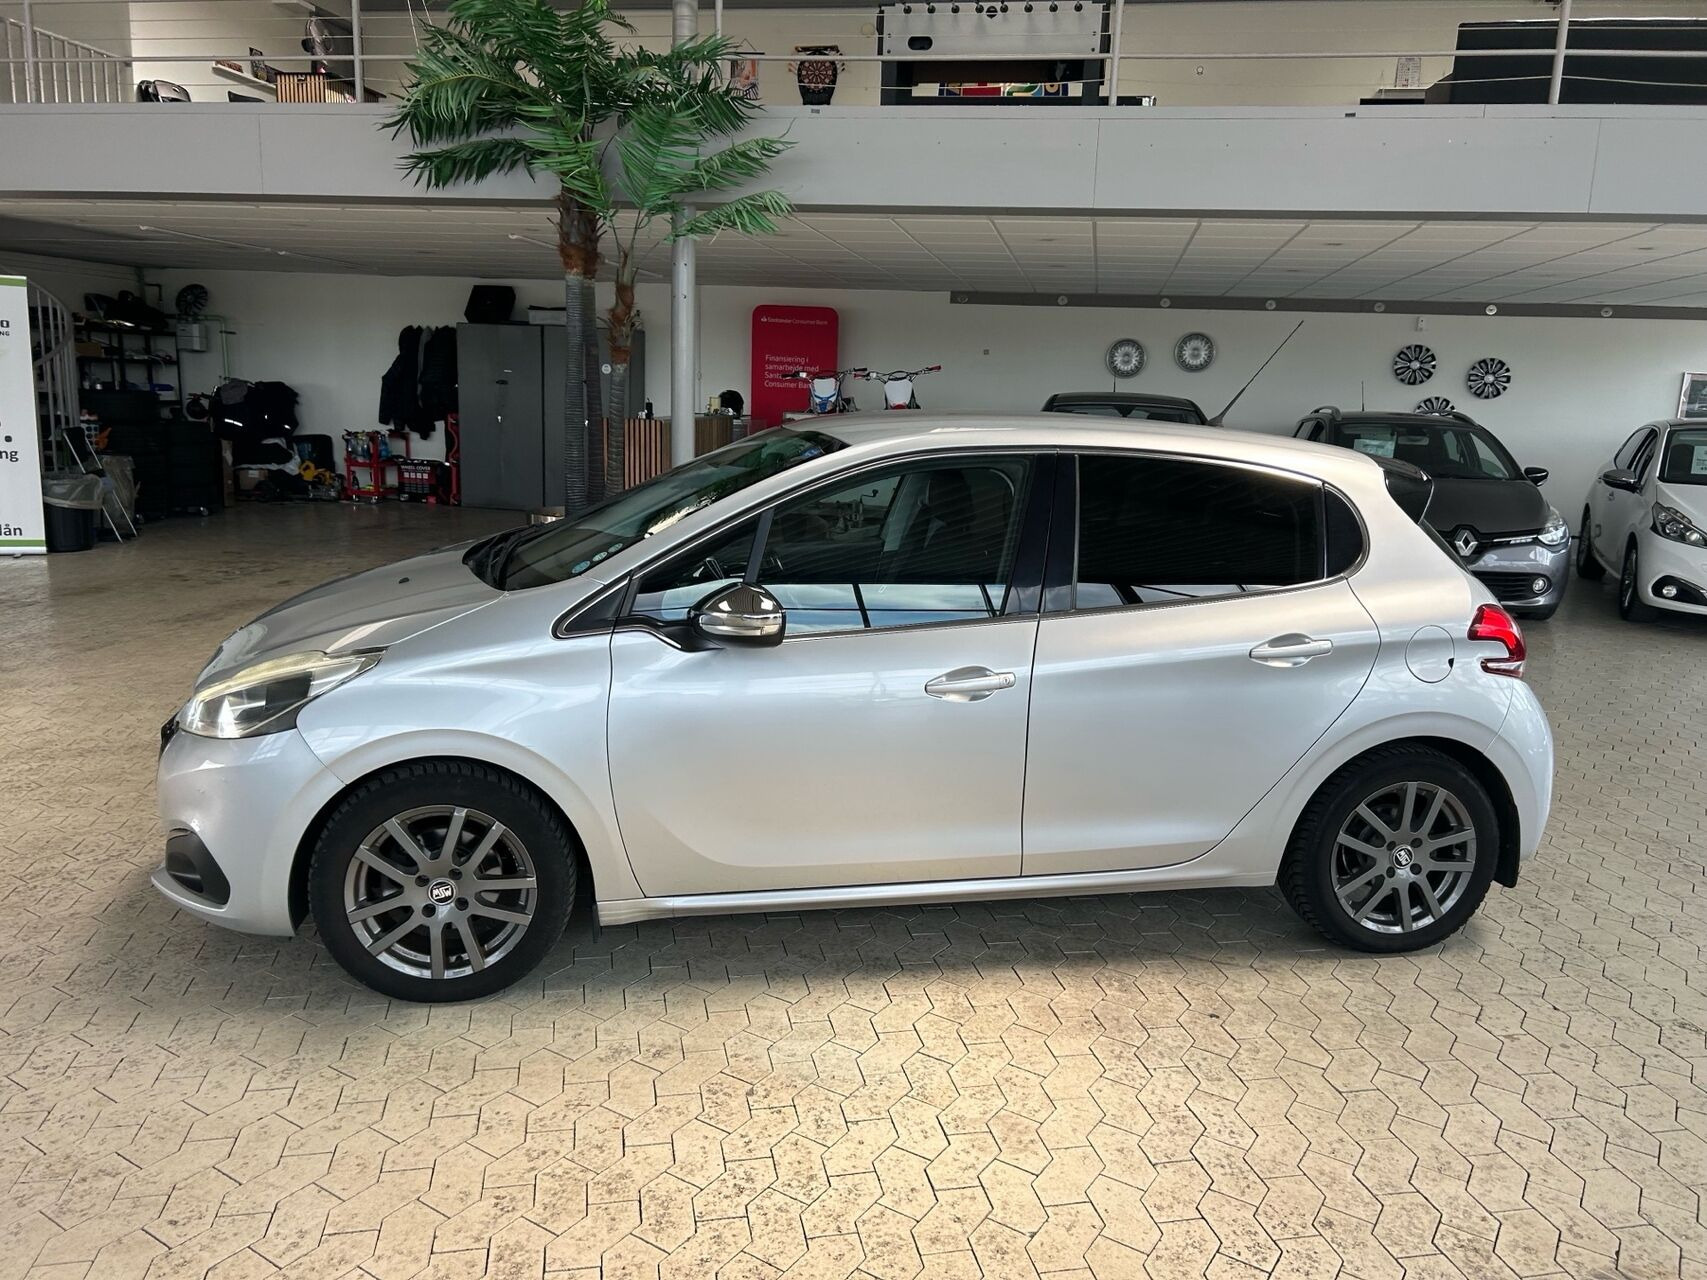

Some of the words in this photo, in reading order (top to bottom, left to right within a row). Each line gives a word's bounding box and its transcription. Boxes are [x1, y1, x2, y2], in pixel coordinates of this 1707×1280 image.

[765, 354, 805, 365] Finansiering
[764, 364, 803, 373] samarbejde
[764, 380, 797, 388] Consumer
[432, 885, 452, 900] MSW
